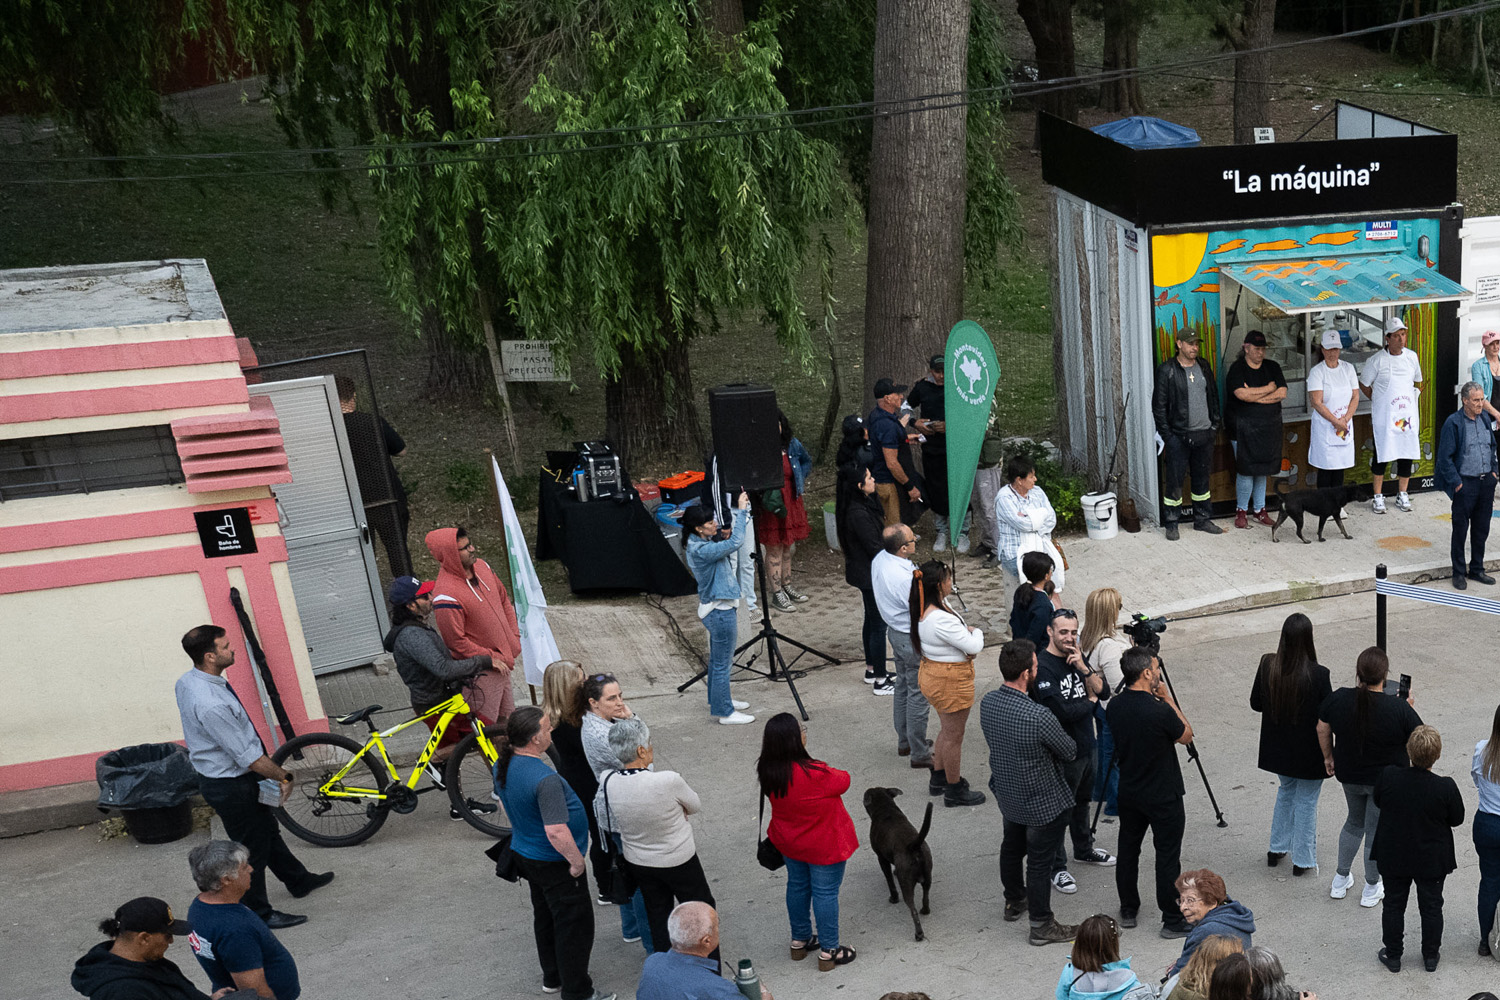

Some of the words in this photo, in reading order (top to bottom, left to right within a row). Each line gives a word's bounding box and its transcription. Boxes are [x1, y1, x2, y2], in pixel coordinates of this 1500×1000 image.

[1372, 221, 1392, 229] MULTI
[953, 343, 988, 369] Montevideo
[415, 725, 442, 775] XTM
